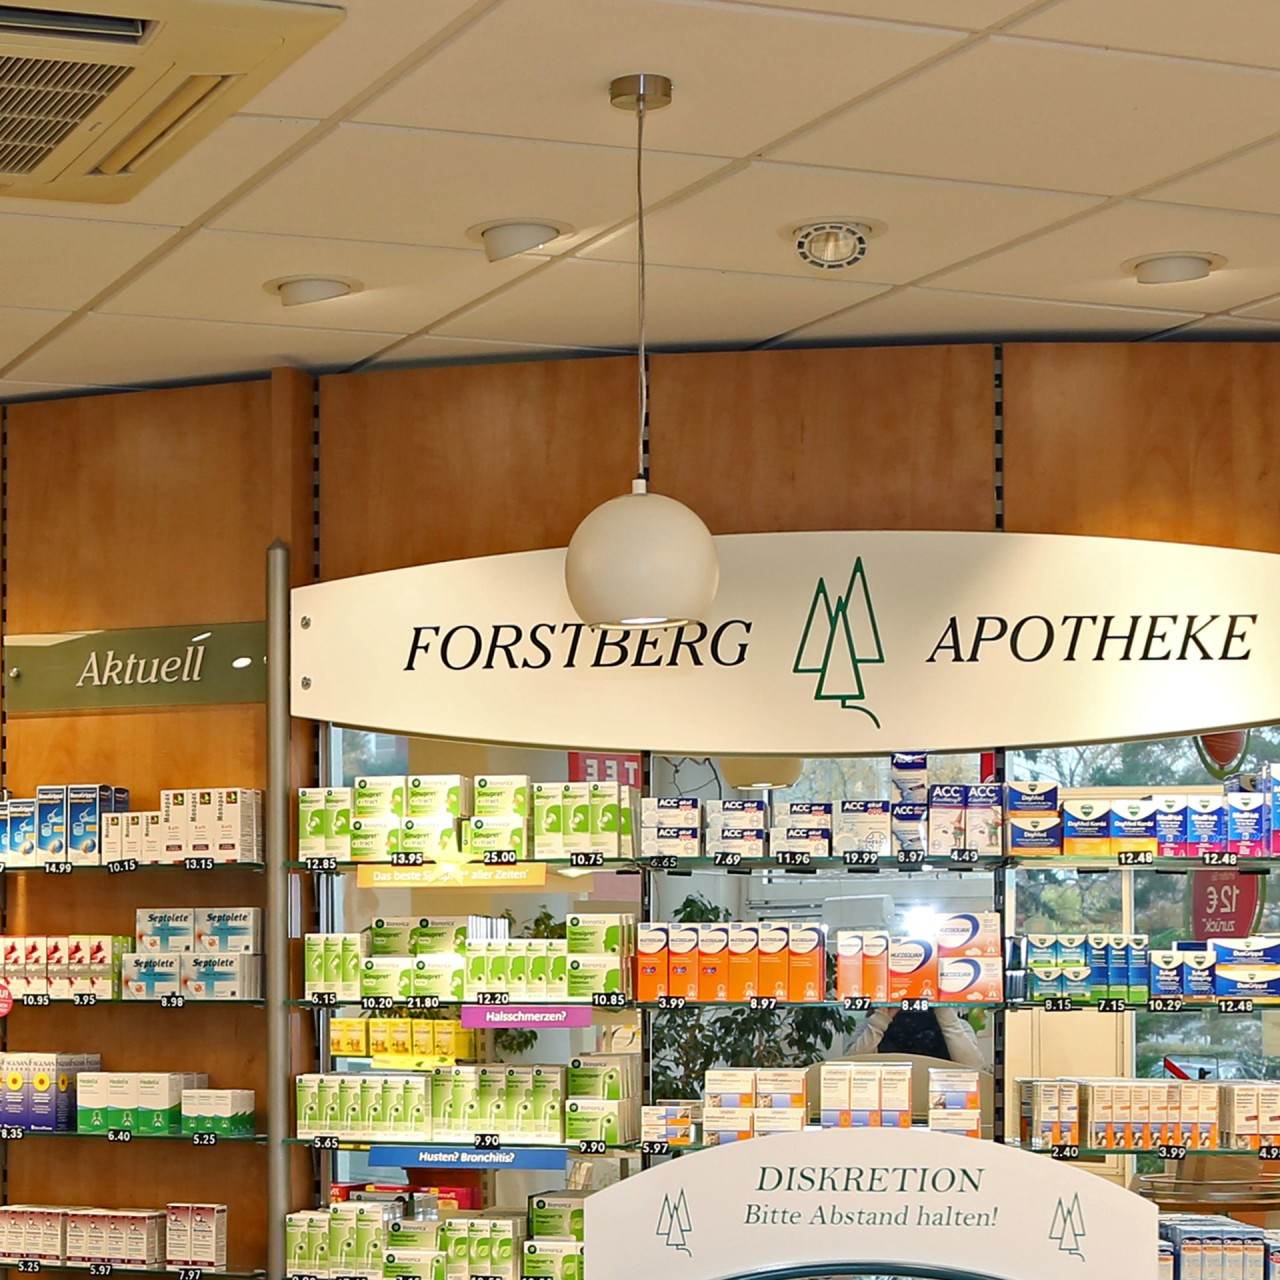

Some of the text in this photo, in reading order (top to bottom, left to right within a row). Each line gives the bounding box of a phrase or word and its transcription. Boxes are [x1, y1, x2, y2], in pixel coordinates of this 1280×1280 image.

[404, 613, 1257, 671] FORSTBERG APOTHEKE
[77, 646, 205, 687] Aktuell
[932, 786, 960, 798] ACC
[659, 798, 678, 807] ACC
[392, 853, 422, 864] 13.95
[485, 852, 516, 863] 25.00
[571, 854, 603, 864] 10.75
[185, 859, 212, 869] 13.15
[373, 871, 390, 880] Das
[394, 871, 420, 880] beste
[148, 913, 191, 922] Septolete
[206, 913, 249, 922] Septolete
[162, 997, 183, 1006] 8.98
[478, 993, 509, 1003] 12.20
[751, 998, 776, 1008] 8.97
[1148, 1000, 1181, 1011] 10.29
[486, 1010, 566, 1021] Halsschmerzen?
[315, 1138, 338, 1148] 5.65
[419, 1151, 514, 1163] Husten? Bronchitis?
[1052, 1147, 1079, 1157] 2.40
[757, 1165, 984, 1192] DISKRETION
[744, 1204, 998, 1227] Bitte Abstand halten!
